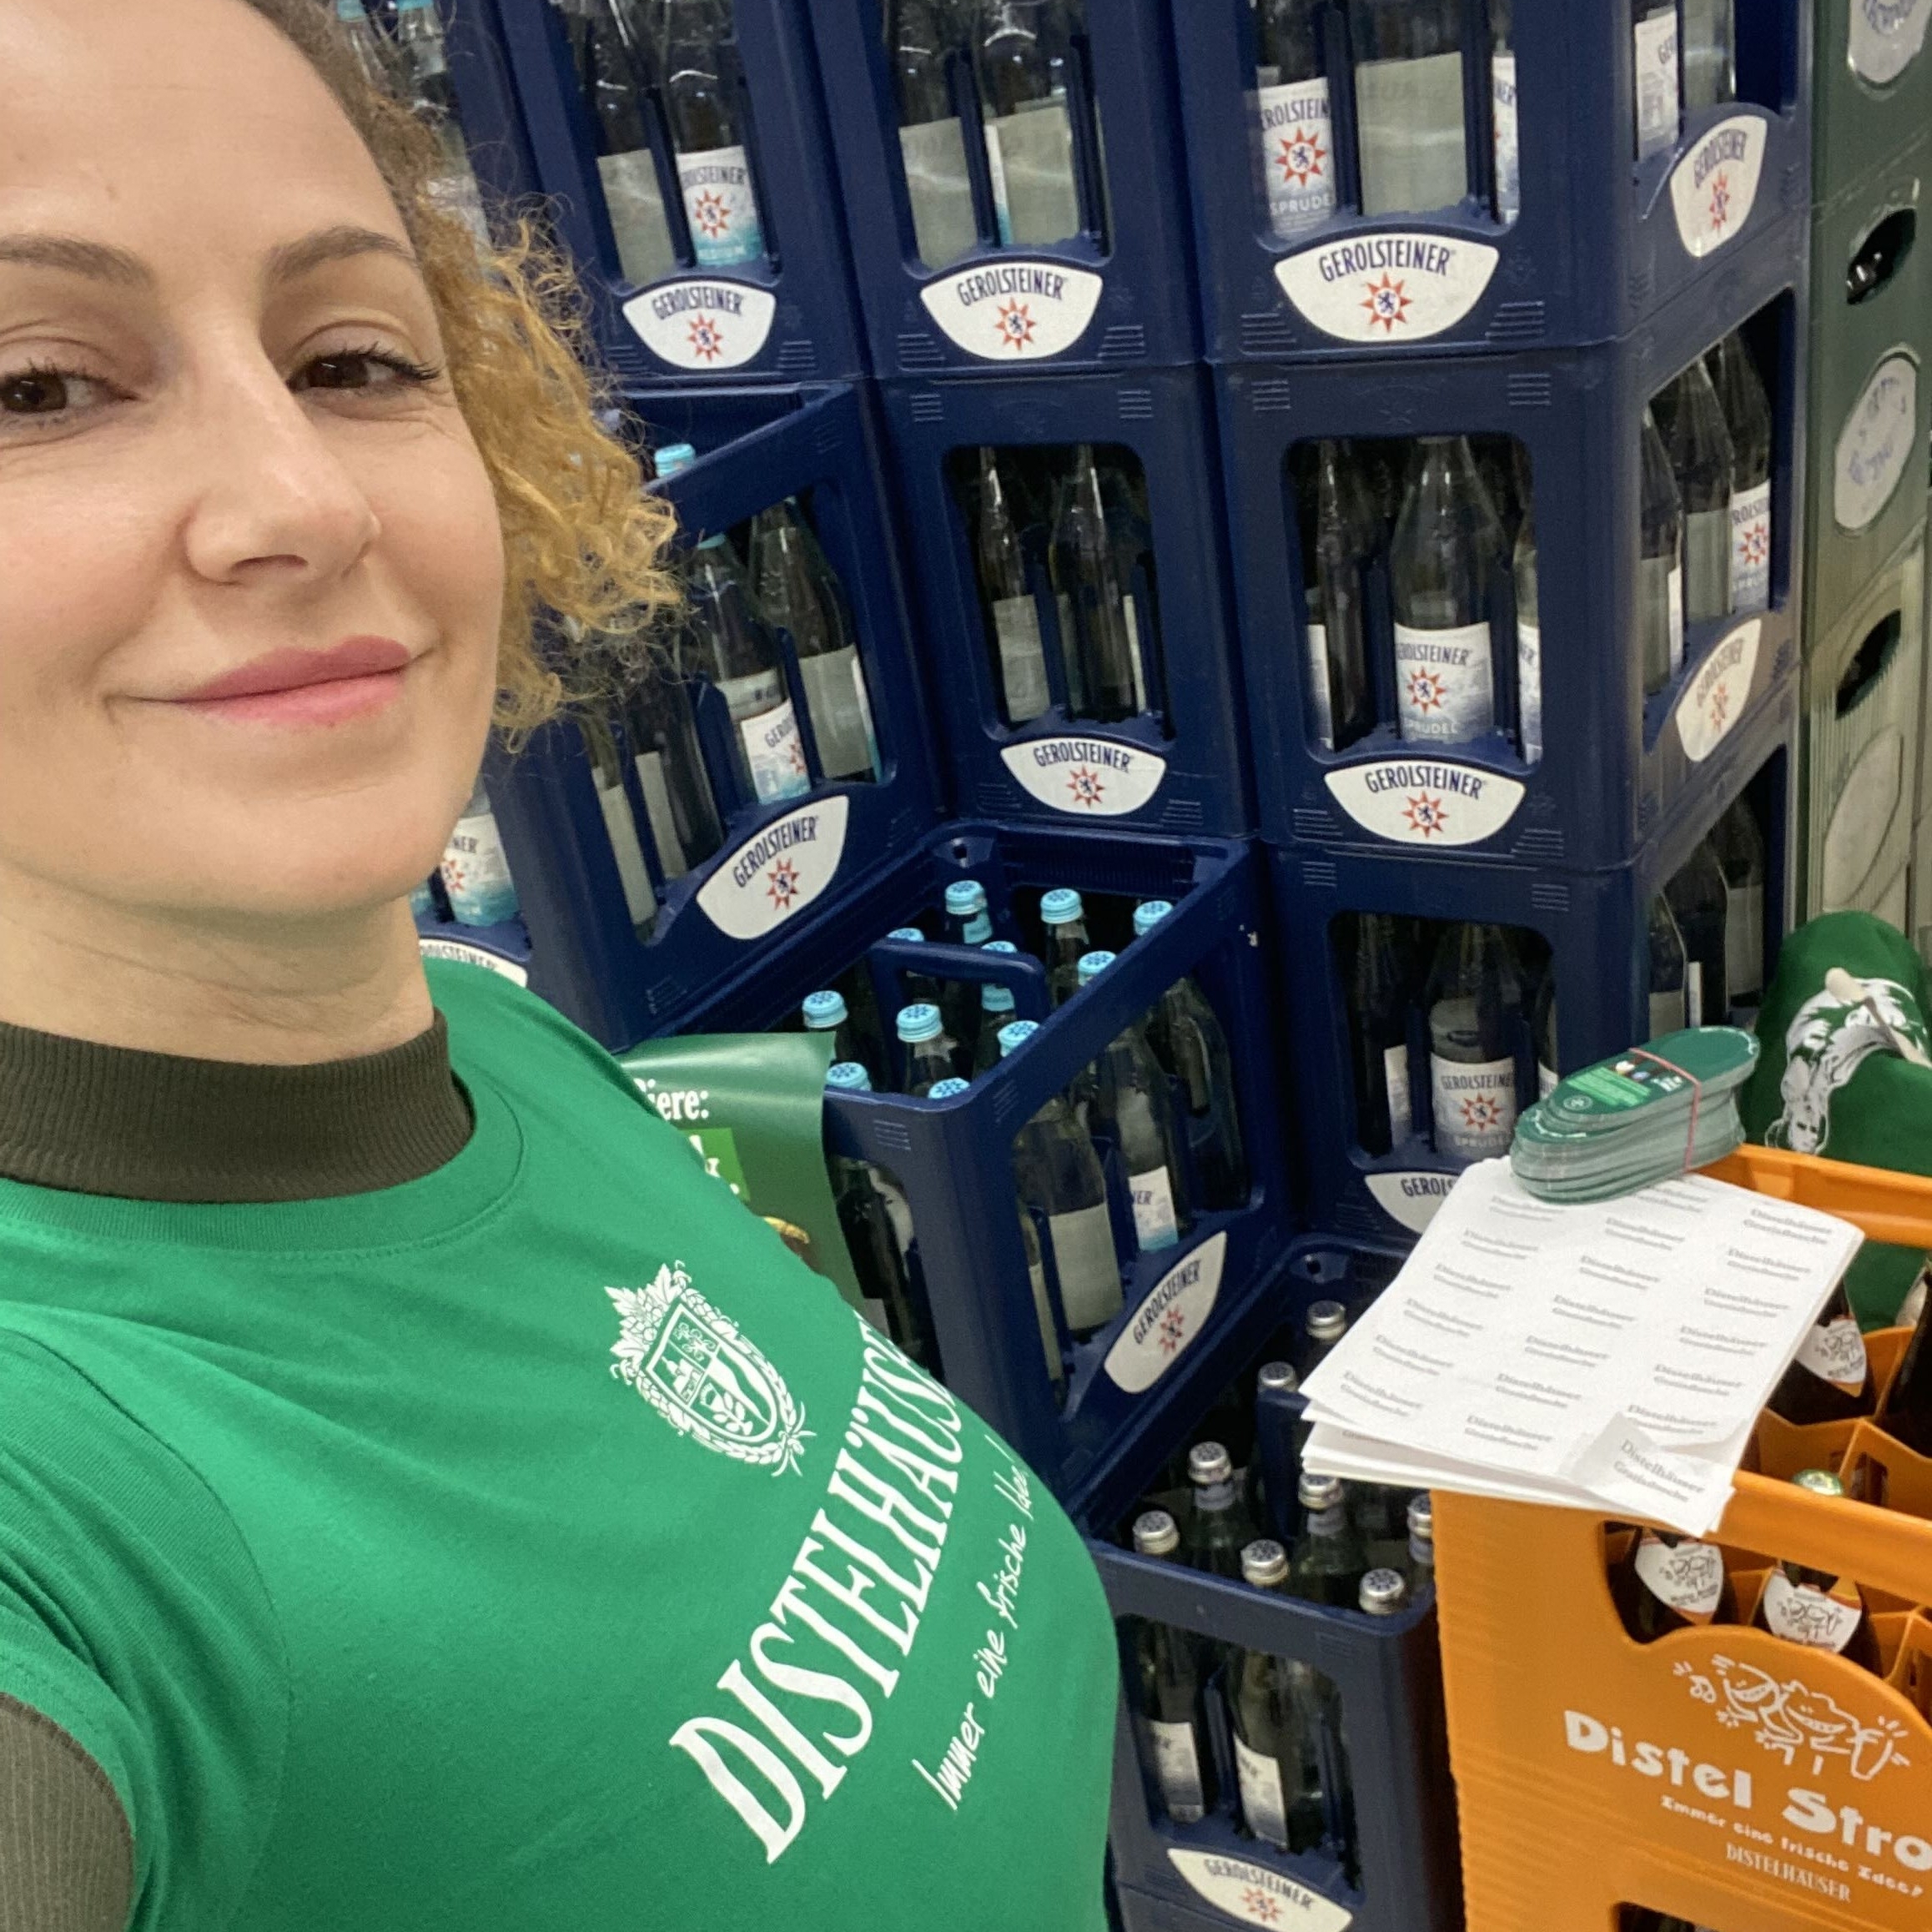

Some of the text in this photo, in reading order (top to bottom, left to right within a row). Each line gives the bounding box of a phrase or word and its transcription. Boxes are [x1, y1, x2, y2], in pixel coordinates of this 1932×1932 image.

[957, 268, 1064, 306] GEROLSTEINER
[1319, 240, 1451, 282] GEROLSTEINER
[652, 286, 743, 320] GEROLSTEINER
[1033, 742, 1131, 773] GEROLSTEINER
[1365, 765, 1482, 799] GEROLSTEINER
[733, 815, 818, 888] GEROLSTEINER
[1133, 1260, 1201, 1345] GEROLSTEINER
[977, 1524, 1027, 1629] frische
[973, 1630, 1008, 1698] eine
[913, 1701, 985, 1810] Immer
[1564, 1710, 1932, 1871] Distel Stro
[1660, 1794, 1727, 1828] Immer
[1733, 1822, 1774, 1844] eine
[1781, 1837, 1849, 1871] frische
[1204, 1858, 1314, 1910] GEROLSTEINER
